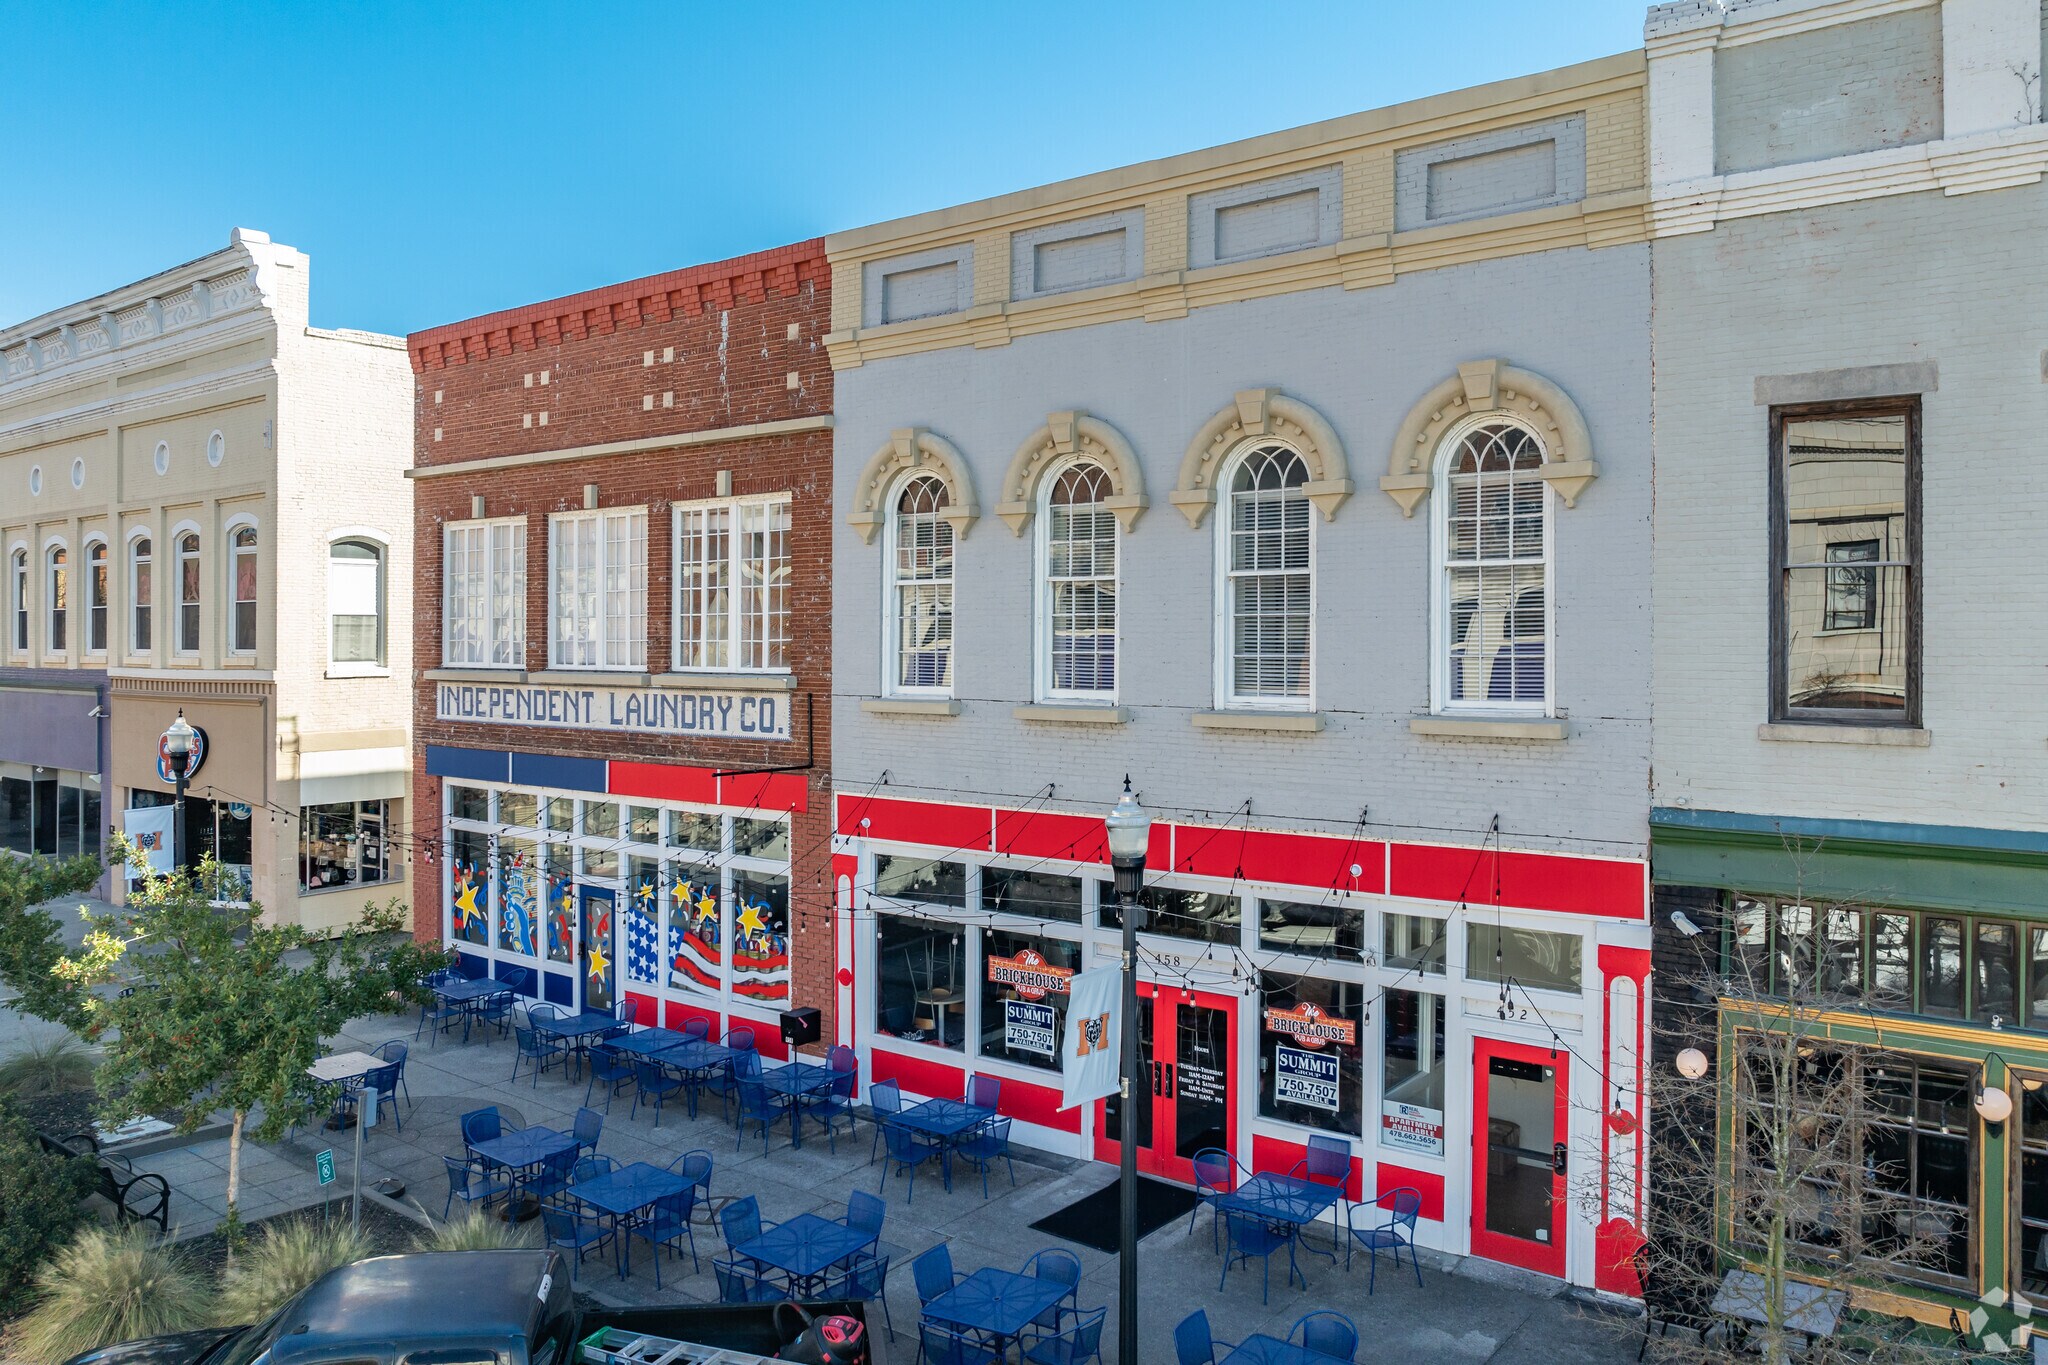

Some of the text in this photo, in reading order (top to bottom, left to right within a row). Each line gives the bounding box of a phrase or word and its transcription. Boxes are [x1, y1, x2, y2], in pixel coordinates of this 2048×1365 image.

[440, 685, 784, 734] INDEPENDENT LAUNDRY CO.
[1022, 949, 1041, 967] The
[1155, 953, 1181, 967] 458
[994, 966, 1064, 992] BRICKHOUSE
[1015, 984, 1027, 993] PUB
[1030, 987, 1046, 996] GRUB
[1008, 1005, 1054, 1025] SUMMIT
[1301, 1002, 1320, 1018] The
[1020, 1019, 1042, 1027] GROUP
[1011, 1027, 1053, 1044] 750-7507
[1013, 1037, 1048, 1050] AVAILABLE
[1294, 1034, 1306, 1042] PUB
[1310, 1037, 1326, 1046] GRUB
[1279, 1053, 1337, 1076] SUMMIT
[1294, 1069, 1321, 1078] GROUP
[1282, 1077, 1337, 1099] 750-7507
[1286, 1090, 1330, 1105] AVAILABLE
[1389, 1116, 1438, 1132] APARTMENT
[1391, 1123, 1435, 1138] AVAILABLE
[1389, 1129, 1437, 1145] 478.662.5656
